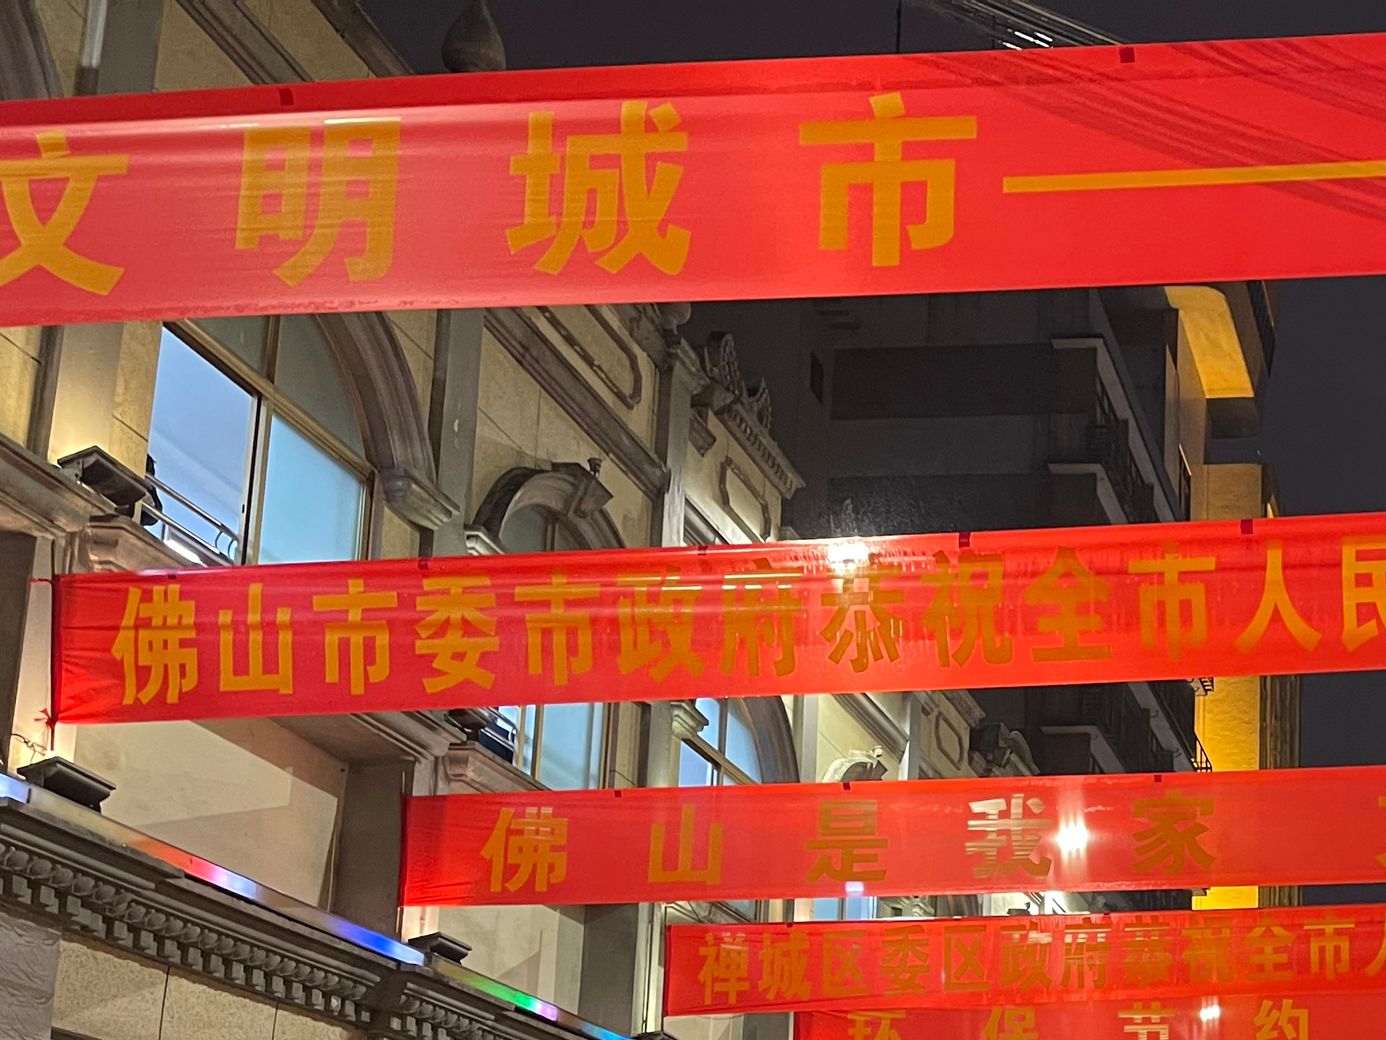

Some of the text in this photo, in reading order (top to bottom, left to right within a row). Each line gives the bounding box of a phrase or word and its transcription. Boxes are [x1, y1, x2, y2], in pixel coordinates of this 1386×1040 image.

[480, 790, 1217, 894] 佛山是我家
